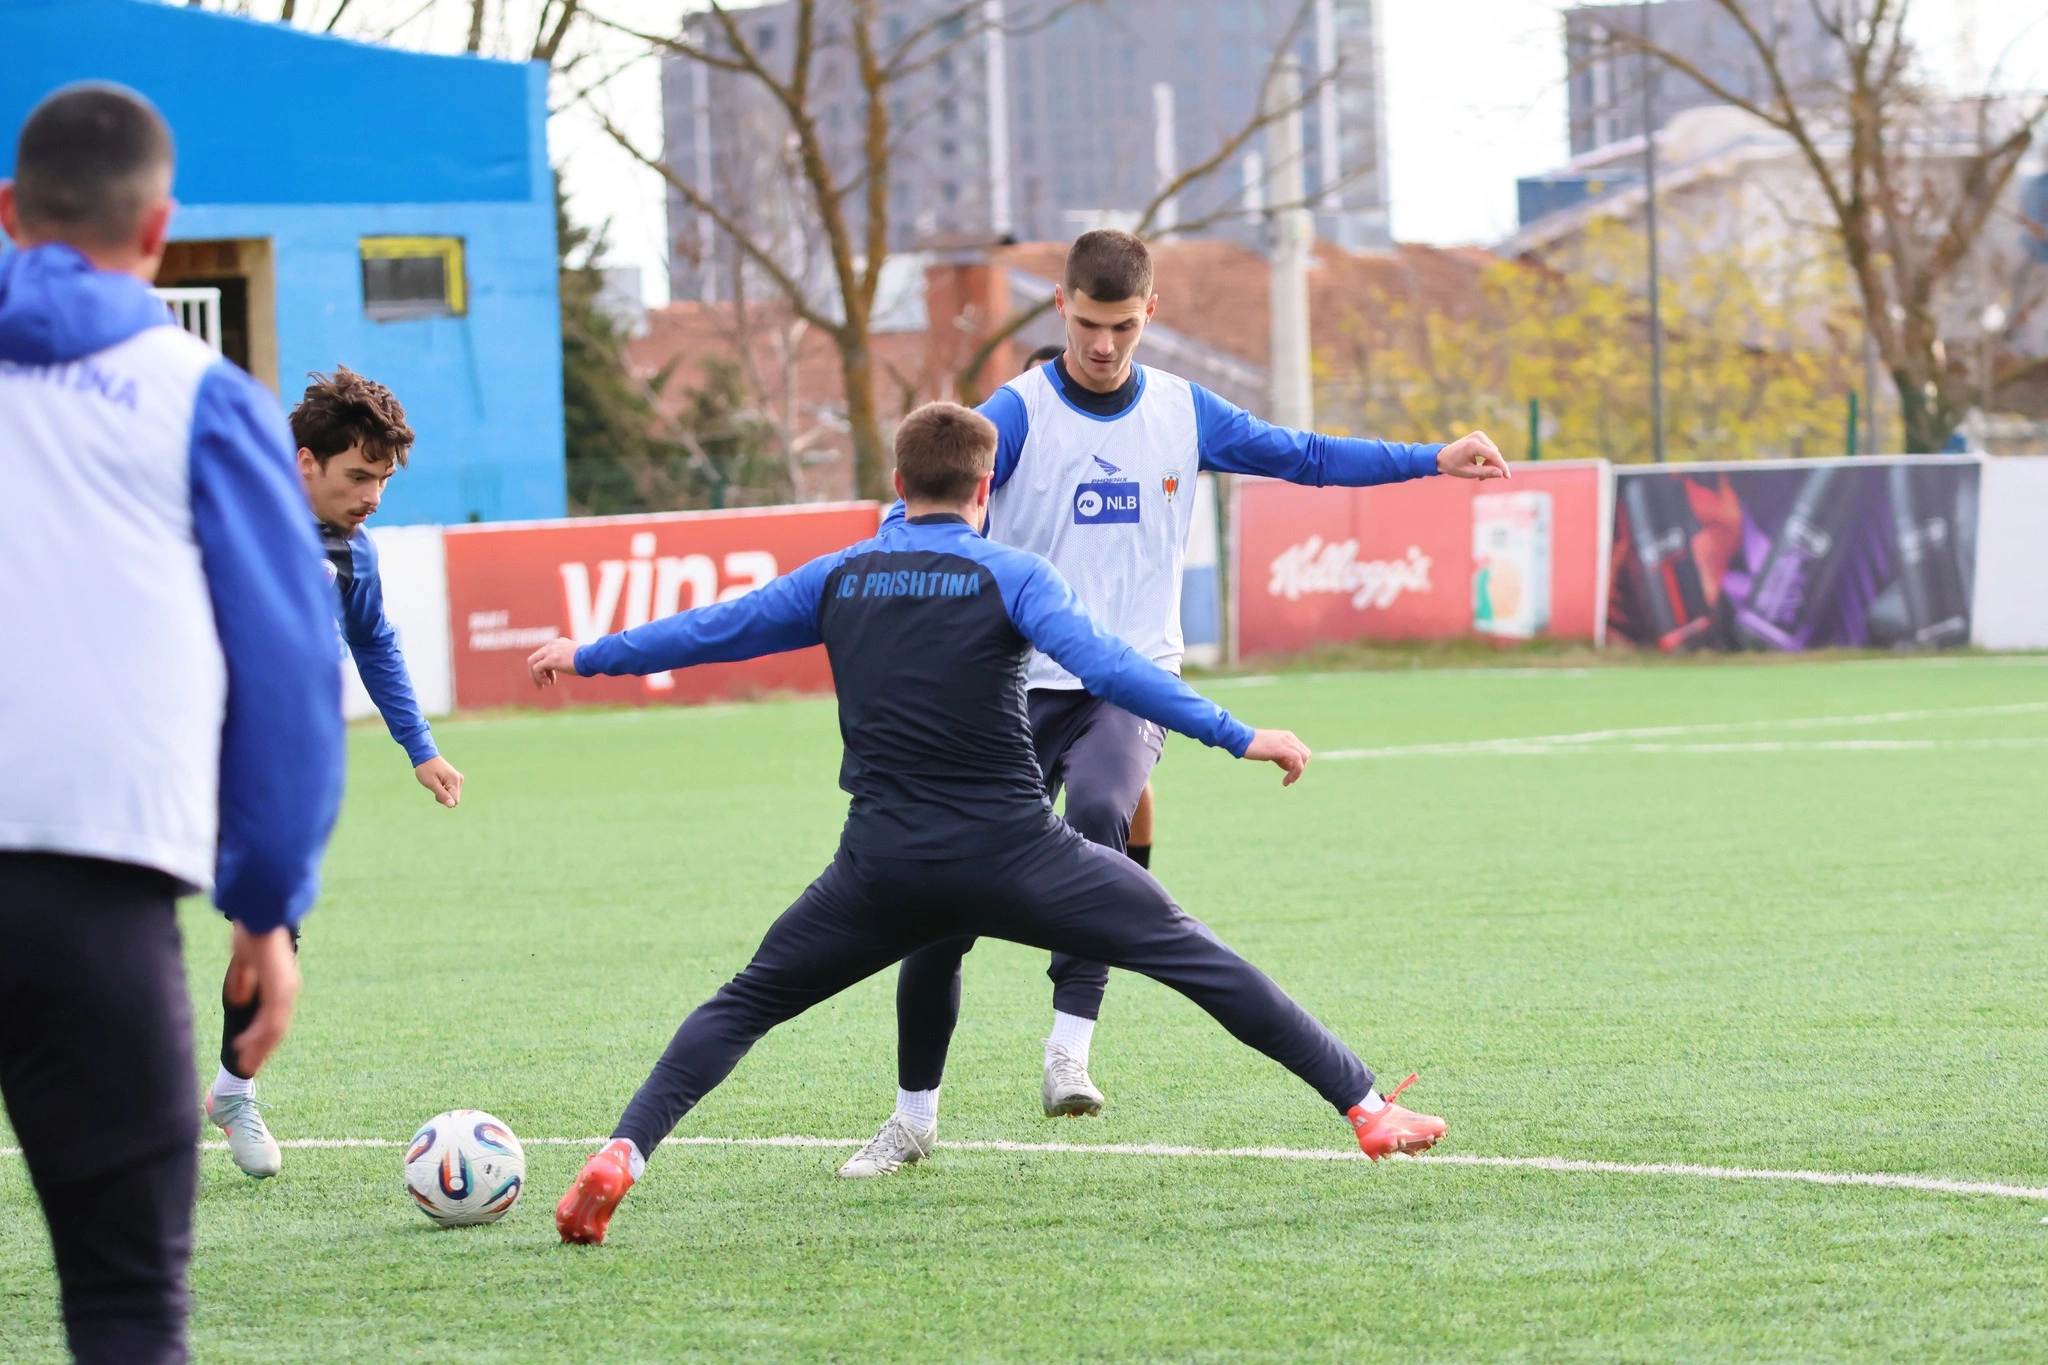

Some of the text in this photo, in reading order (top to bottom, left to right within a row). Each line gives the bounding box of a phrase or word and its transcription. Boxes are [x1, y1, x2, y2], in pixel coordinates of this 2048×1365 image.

[1106, 496, 1137, 510] NLB
[862, 569, 980, 599] PRISHTINA
[1268, 534, 1433, 609] Kellogg's
